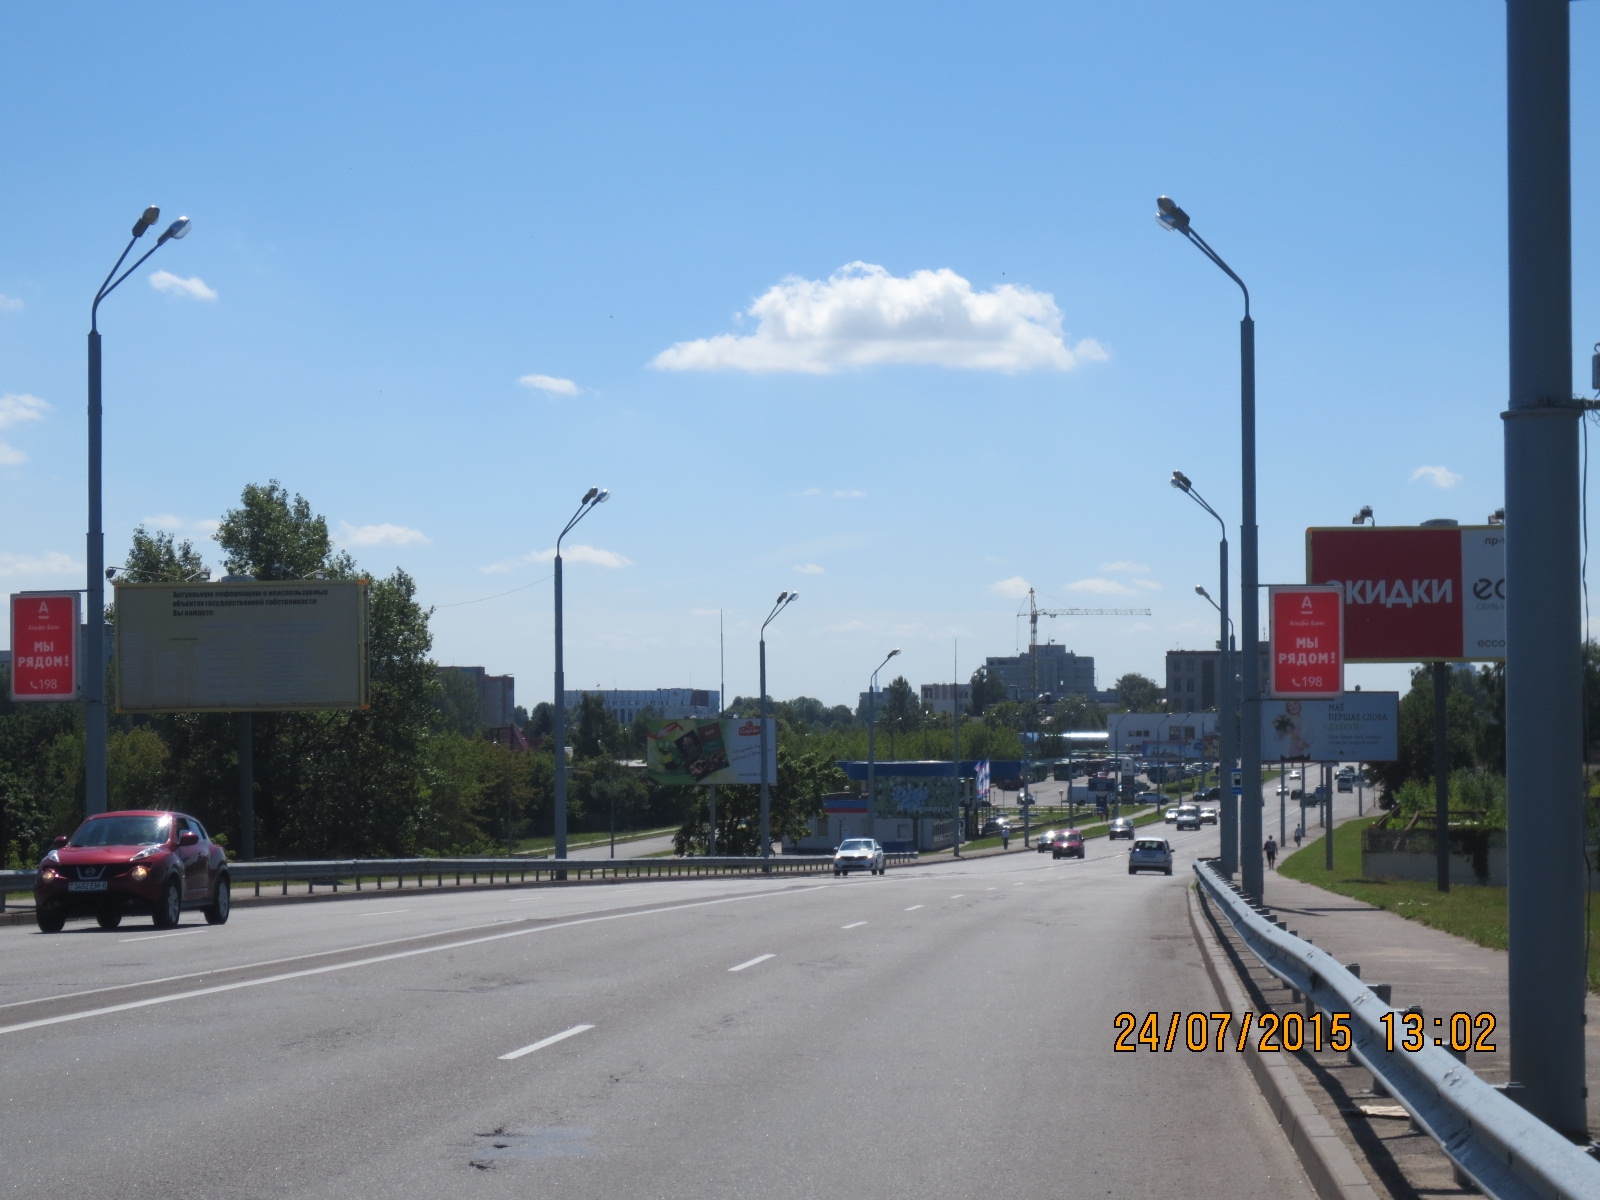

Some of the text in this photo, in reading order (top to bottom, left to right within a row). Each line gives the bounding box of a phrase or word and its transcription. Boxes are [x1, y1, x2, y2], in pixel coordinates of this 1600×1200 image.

[215, 590, 262, 600] информацию
[269, 589, 329, 598] неиспользуемых
[1324, 578, 1454, 609] КИДКИ
[206, 598, 265, 607] государственной
[265, 598, 317, 606] собственности
[172, 609, 183, 617] Вы
[17, 654, 70, 670] РЯДОМ!
[1278, 651, 1337, 667] РЯДОМ!
[38, 679, 58, 690] 198
[1301, 676, 1323, 688] 198
[1362, 713, 1388, 721] СЛОВА
